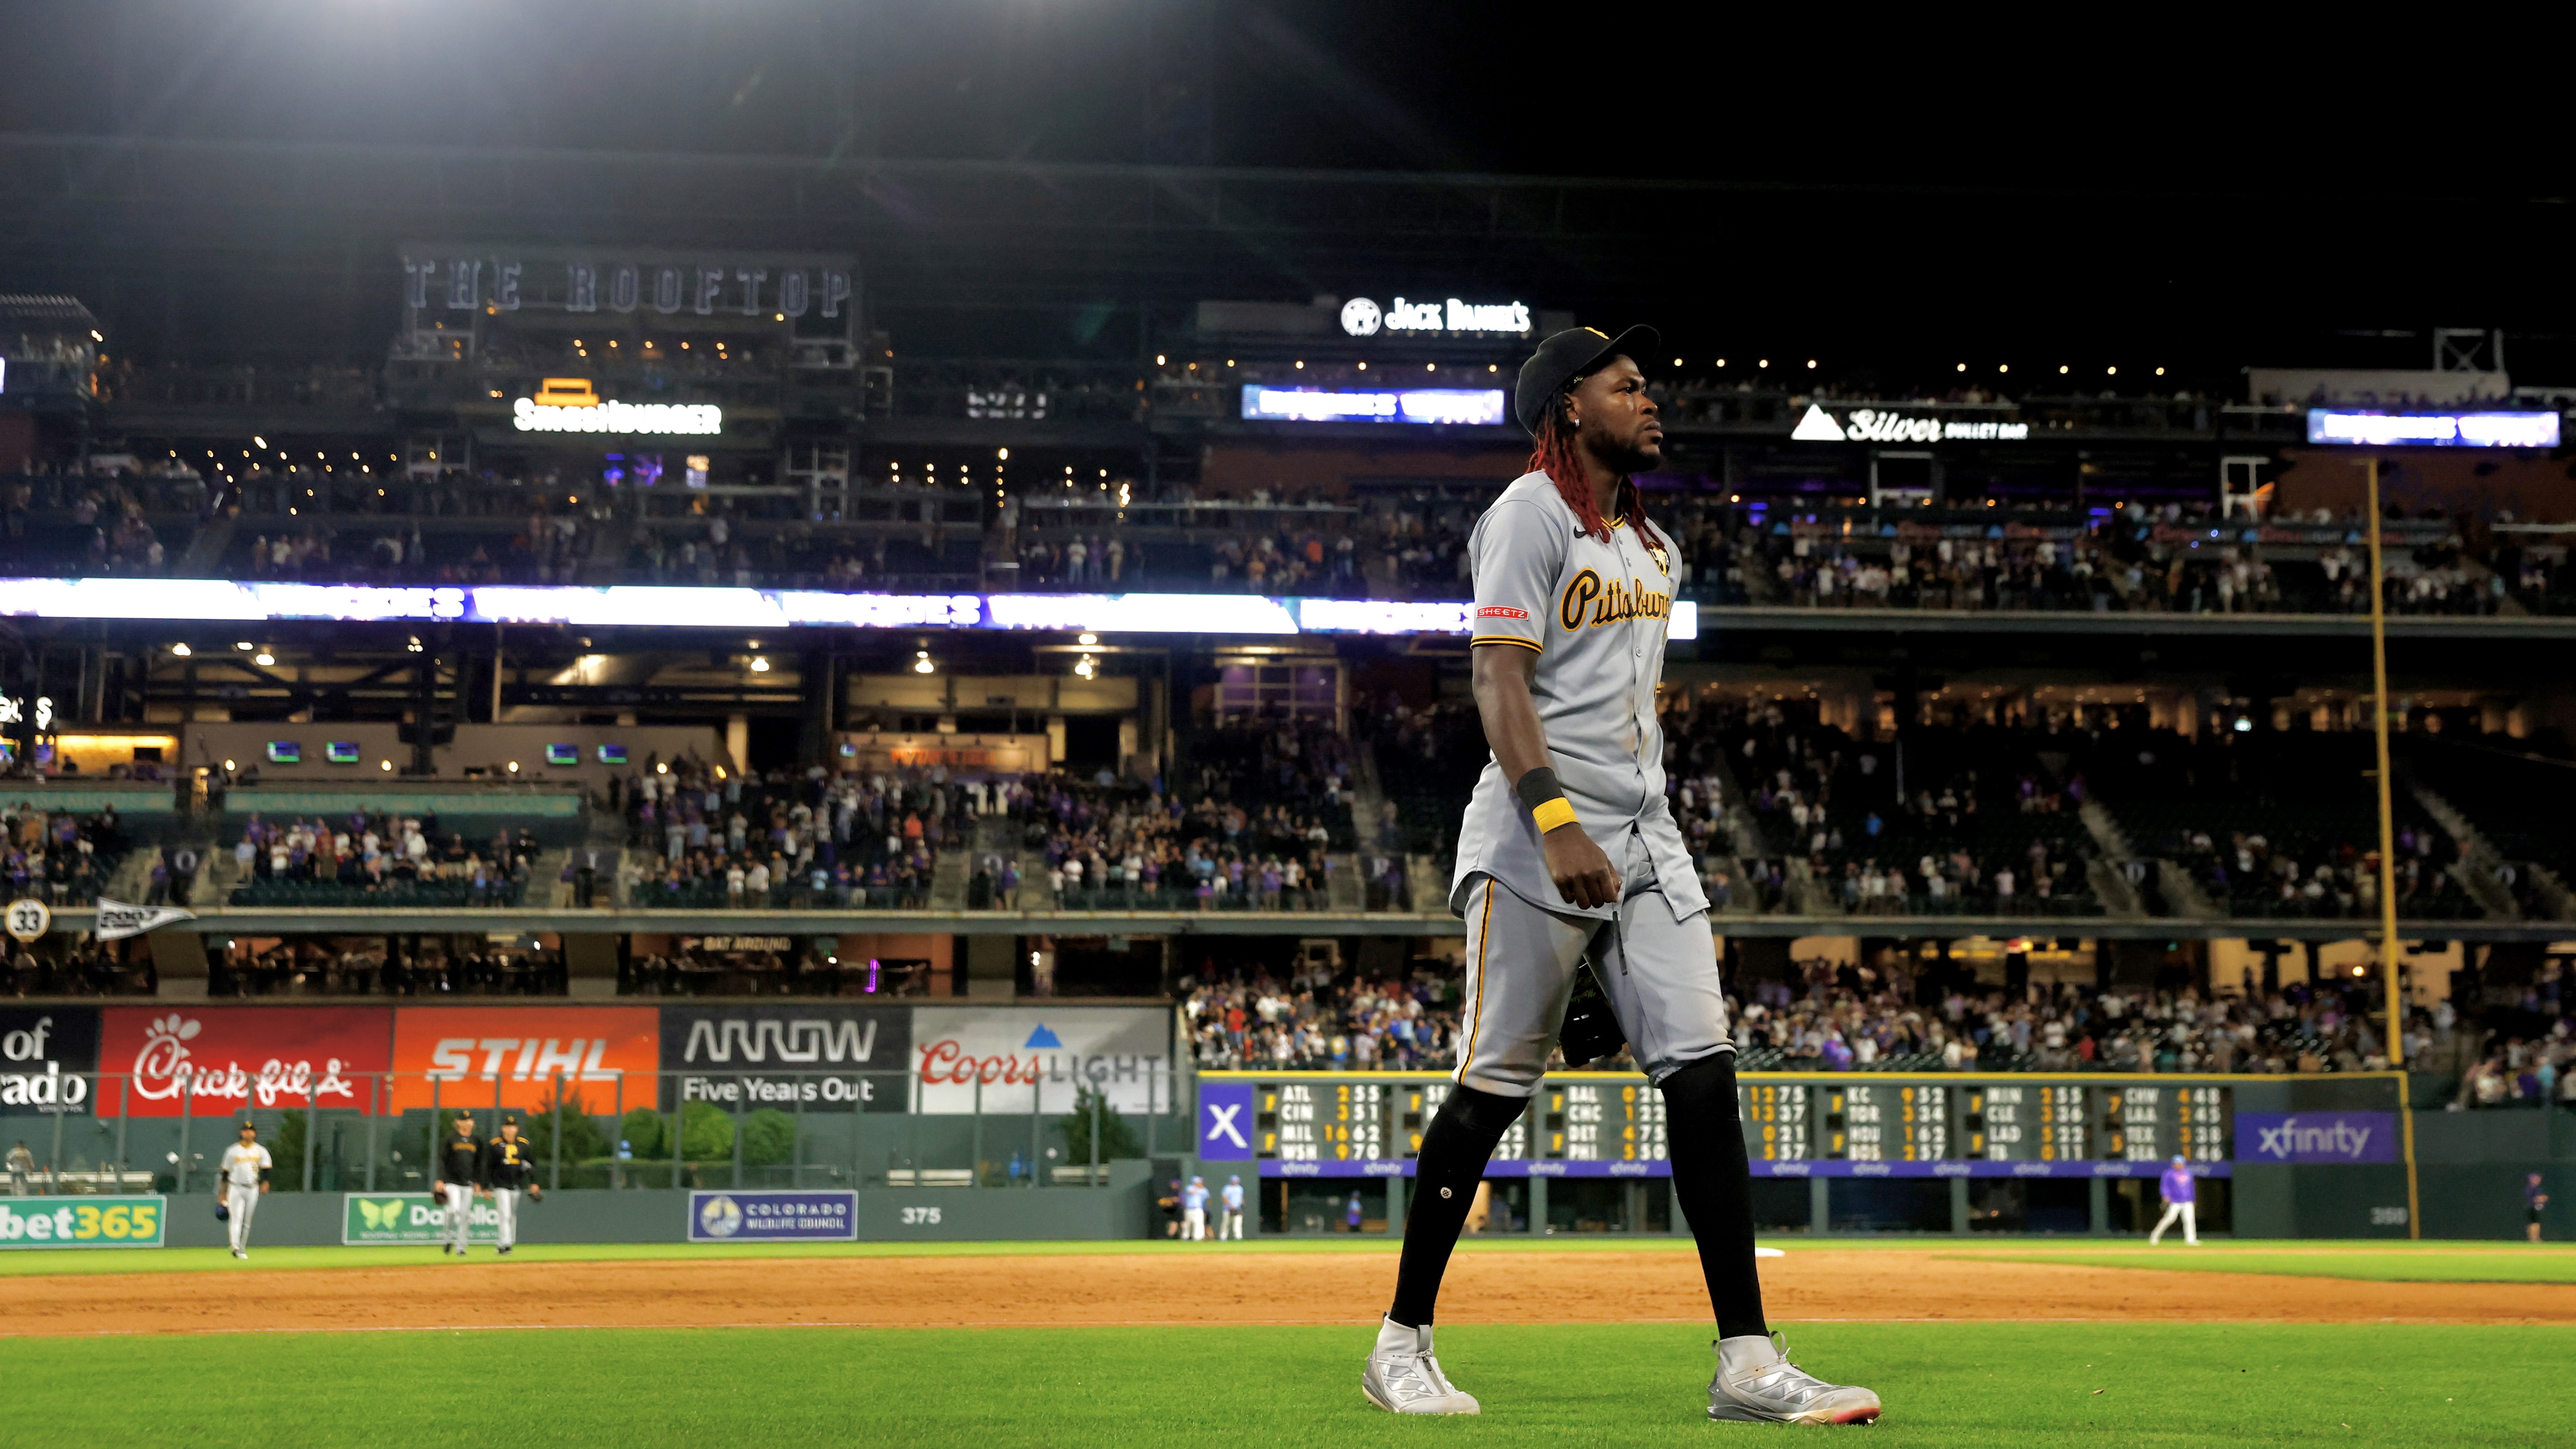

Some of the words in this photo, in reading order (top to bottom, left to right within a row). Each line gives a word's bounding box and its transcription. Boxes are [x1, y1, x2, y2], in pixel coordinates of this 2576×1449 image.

[405, 260, 521, 310] THE
[567, 262, 850, 317] ROOFTOP
[1846, 409, 1943, 442] Silver
[1944, 422, 1997, 440] BULLET
[1479, 608, 1525, 618] SHEETZ
[14, 911, 40, 932] 33
[3, 1016, 53, 1061] of
[684, 1020, 877, 1062] ARROW
[426, 1039, 623, 1081] STIHL
[920, 1040, 1044, 1085] Coors
[1049, 1055, 1162, 1083] LIGHT
[133, 1034, 354, 1106] ChickfilA
[684, 1078, 738, 1101] Five
[743, 1078, 818, 1102] Years
[826, 1079, 873, 1102] Out
[1283, 1084, 1311, 1103] ATL
[1337, 1085, 1349, 1103] 2
[1569, 1085, 1598, 1103] BAL
[1847, 1086, 1871, 1104] KC
[1901, 1087, 1914, 1104] 9
[1281, 1103, 1313, 1121] CIN
[1337, 1103, 1349, 1121] 3
[1568, 1104, 1603, 1122] CHC
[1625, 1104, 1634, 1121] 1
[1639, 1104, 1666, 1122] 22
[1751, 1104, 1775, 1122] 13
[1779, 1104, 1806, 1122] 37
[1902, 1104, 1915, 1123] 3
[1918, 1104, 1945, 1123] 34
[2107, 1096, 2122, 1114] 7
[1208, 1104, 1248, 1148] X
[1282, 1124, 1313, 1141] MIL
[1324, 1124, 1349, 1142] 16
[1352, 1124, 1380, 1142] 62
[1623, 1124, 1636, 1141] 4
[1779, 1124, 1804, 1142] 21
[1904, 1125, 1913, 1142] 1
[1918, 1125, 1945, 1143] 62
[2057, 1125, 2084, 1143] 22
[2259, 1118, 2372, 1158] xfinity
[1335, 1143, 1349, 1161] 9
[1353, 1143, 1380, 1161] 70
[1568, 1143, 1597, 1161] PHI
[1623, 1143, 1635, 1161] 5
[1639, 1143, 1666, 1161] 50
[2059, 1144, 2083, 1161] 11
[746, 1203, 847, 1216] COLORADO
[901, 1207, 941, 1224] 375
[797, 1217, 846, 1229] COUNCIL
